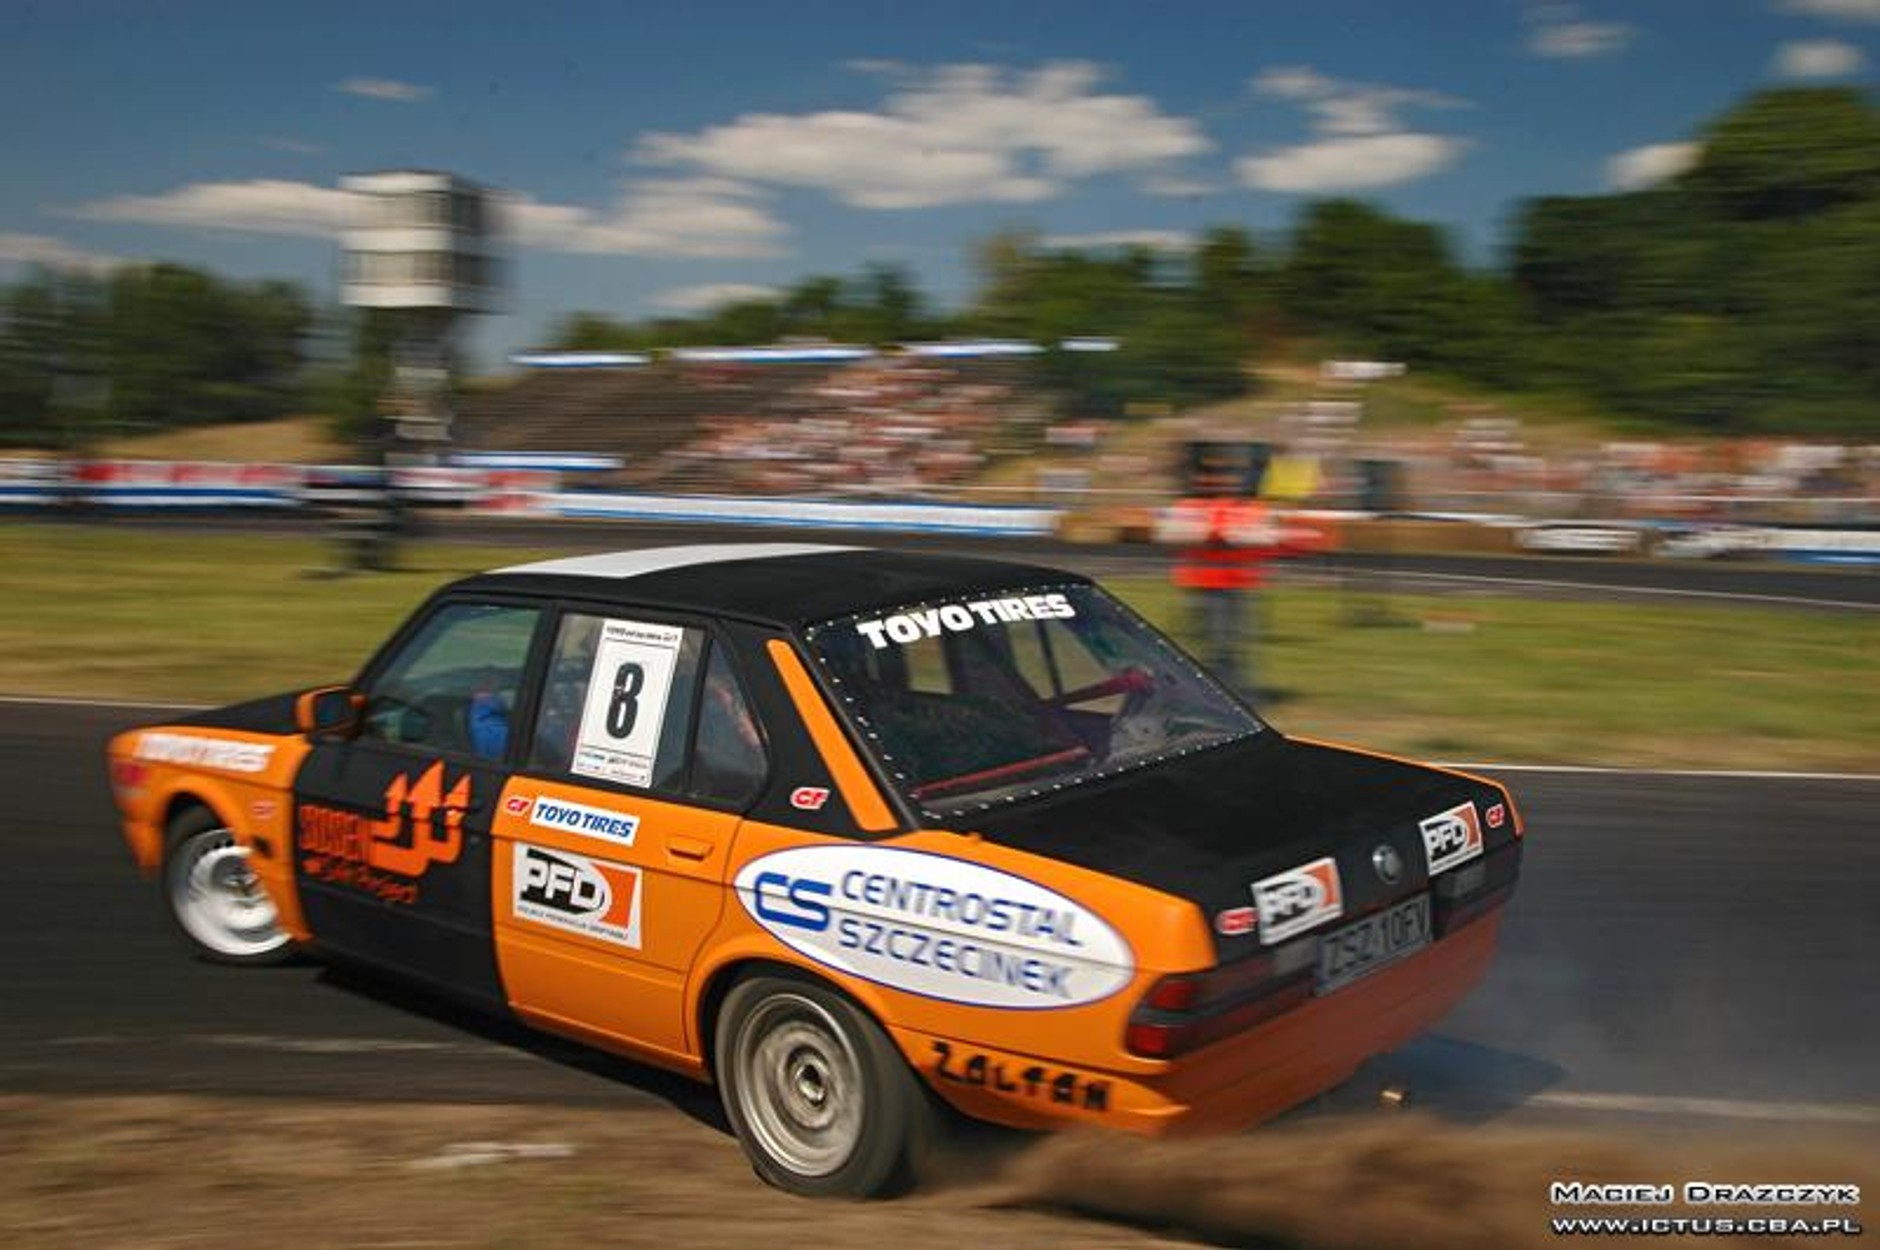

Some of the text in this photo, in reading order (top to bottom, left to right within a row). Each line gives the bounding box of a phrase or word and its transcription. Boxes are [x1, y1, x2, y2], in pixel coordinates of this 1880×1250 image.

[855, 594, 1077, 650] TOYO TIRES
[605, 661, 646, 740] 8
[535, 802, 634, 838] TOYO TIRES
[1424, 819, 1467, 863] PFD
[521, 851, 607, 913] PFD
[754, 871, 832, 932] CS
[841, 869, 1084, 947] CENTROSTAL
[838, 918, 1072, 999] SZCZECINEK
